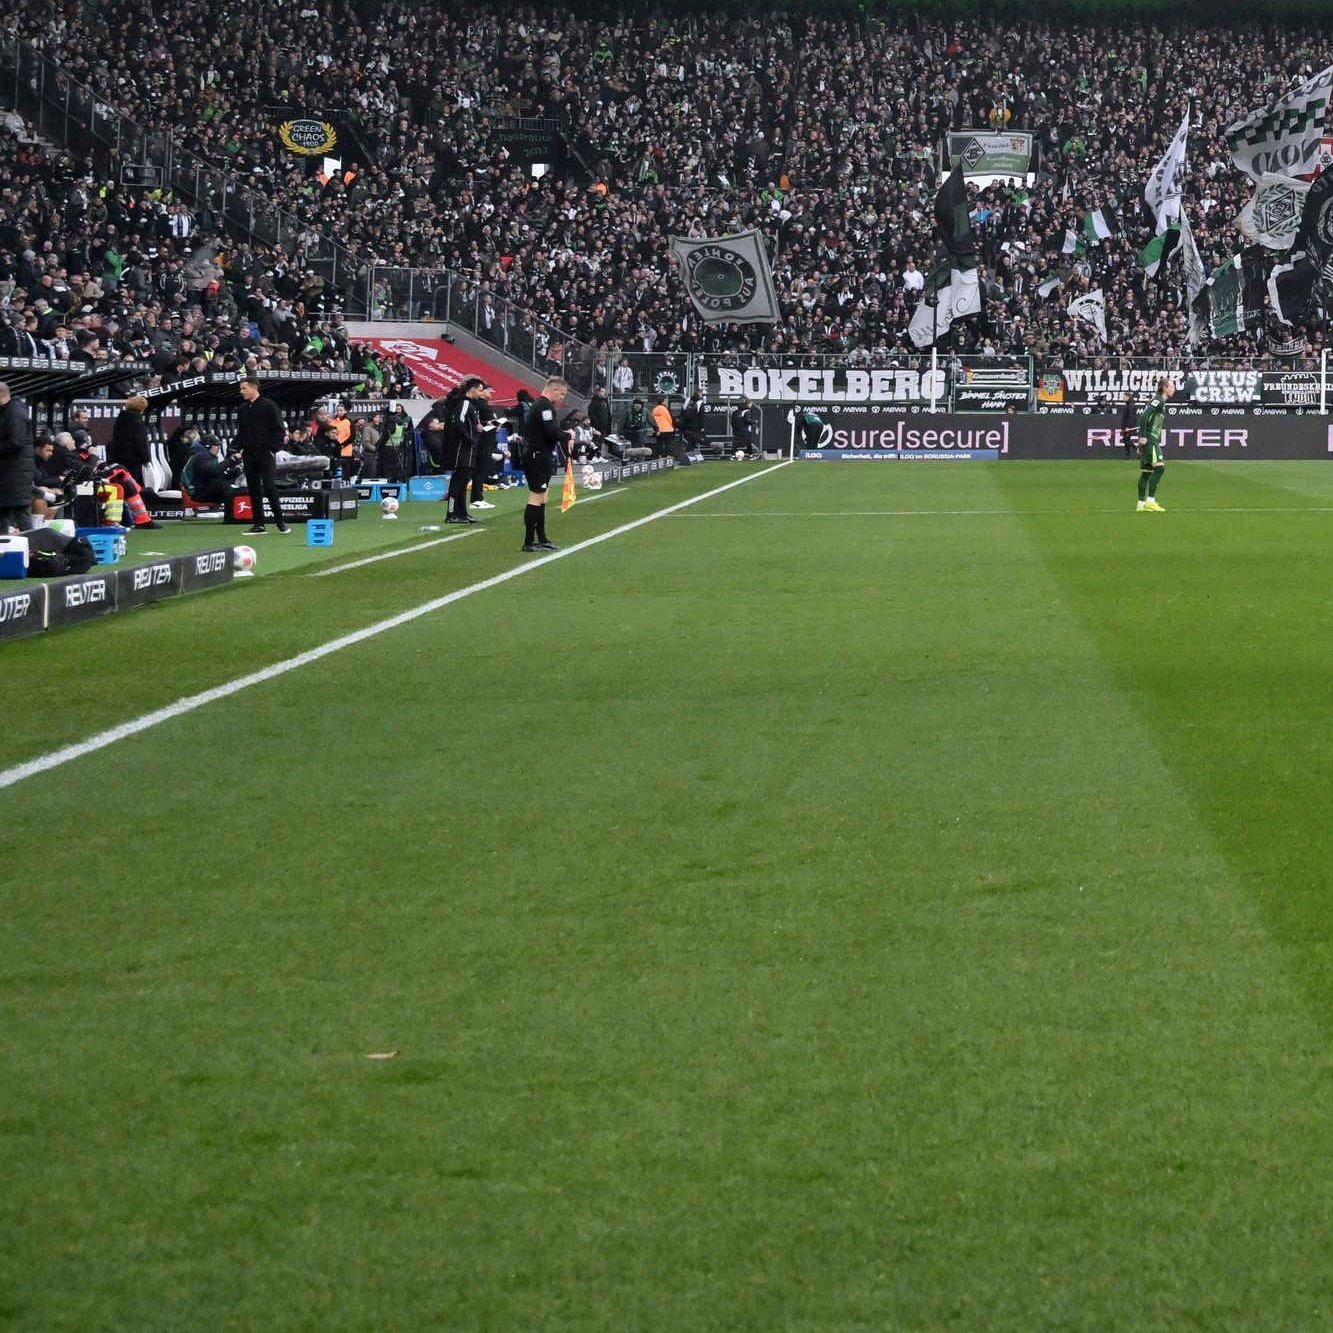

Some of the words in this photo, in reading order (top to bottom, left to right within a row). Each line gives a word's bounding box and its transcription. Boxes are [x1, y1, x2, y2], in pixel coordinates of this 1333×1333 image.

[291, 132, 325, 142] CHAOS
[292, 125, 322, 133] GREEN
[137, 376, 206, 399] REUTER
[718, 366, 946, 401] BÖKELBERG
[1190, 371, 1258, 387] VITUS
[1196, 387, 1254, 402] CREW
[833, 421, 1009, 453] sure[secure]
[195, 553, 226, 575] REUTER
[134, 564, 171, 590] REUTER
[66, 580, 105, 607] REUTER
